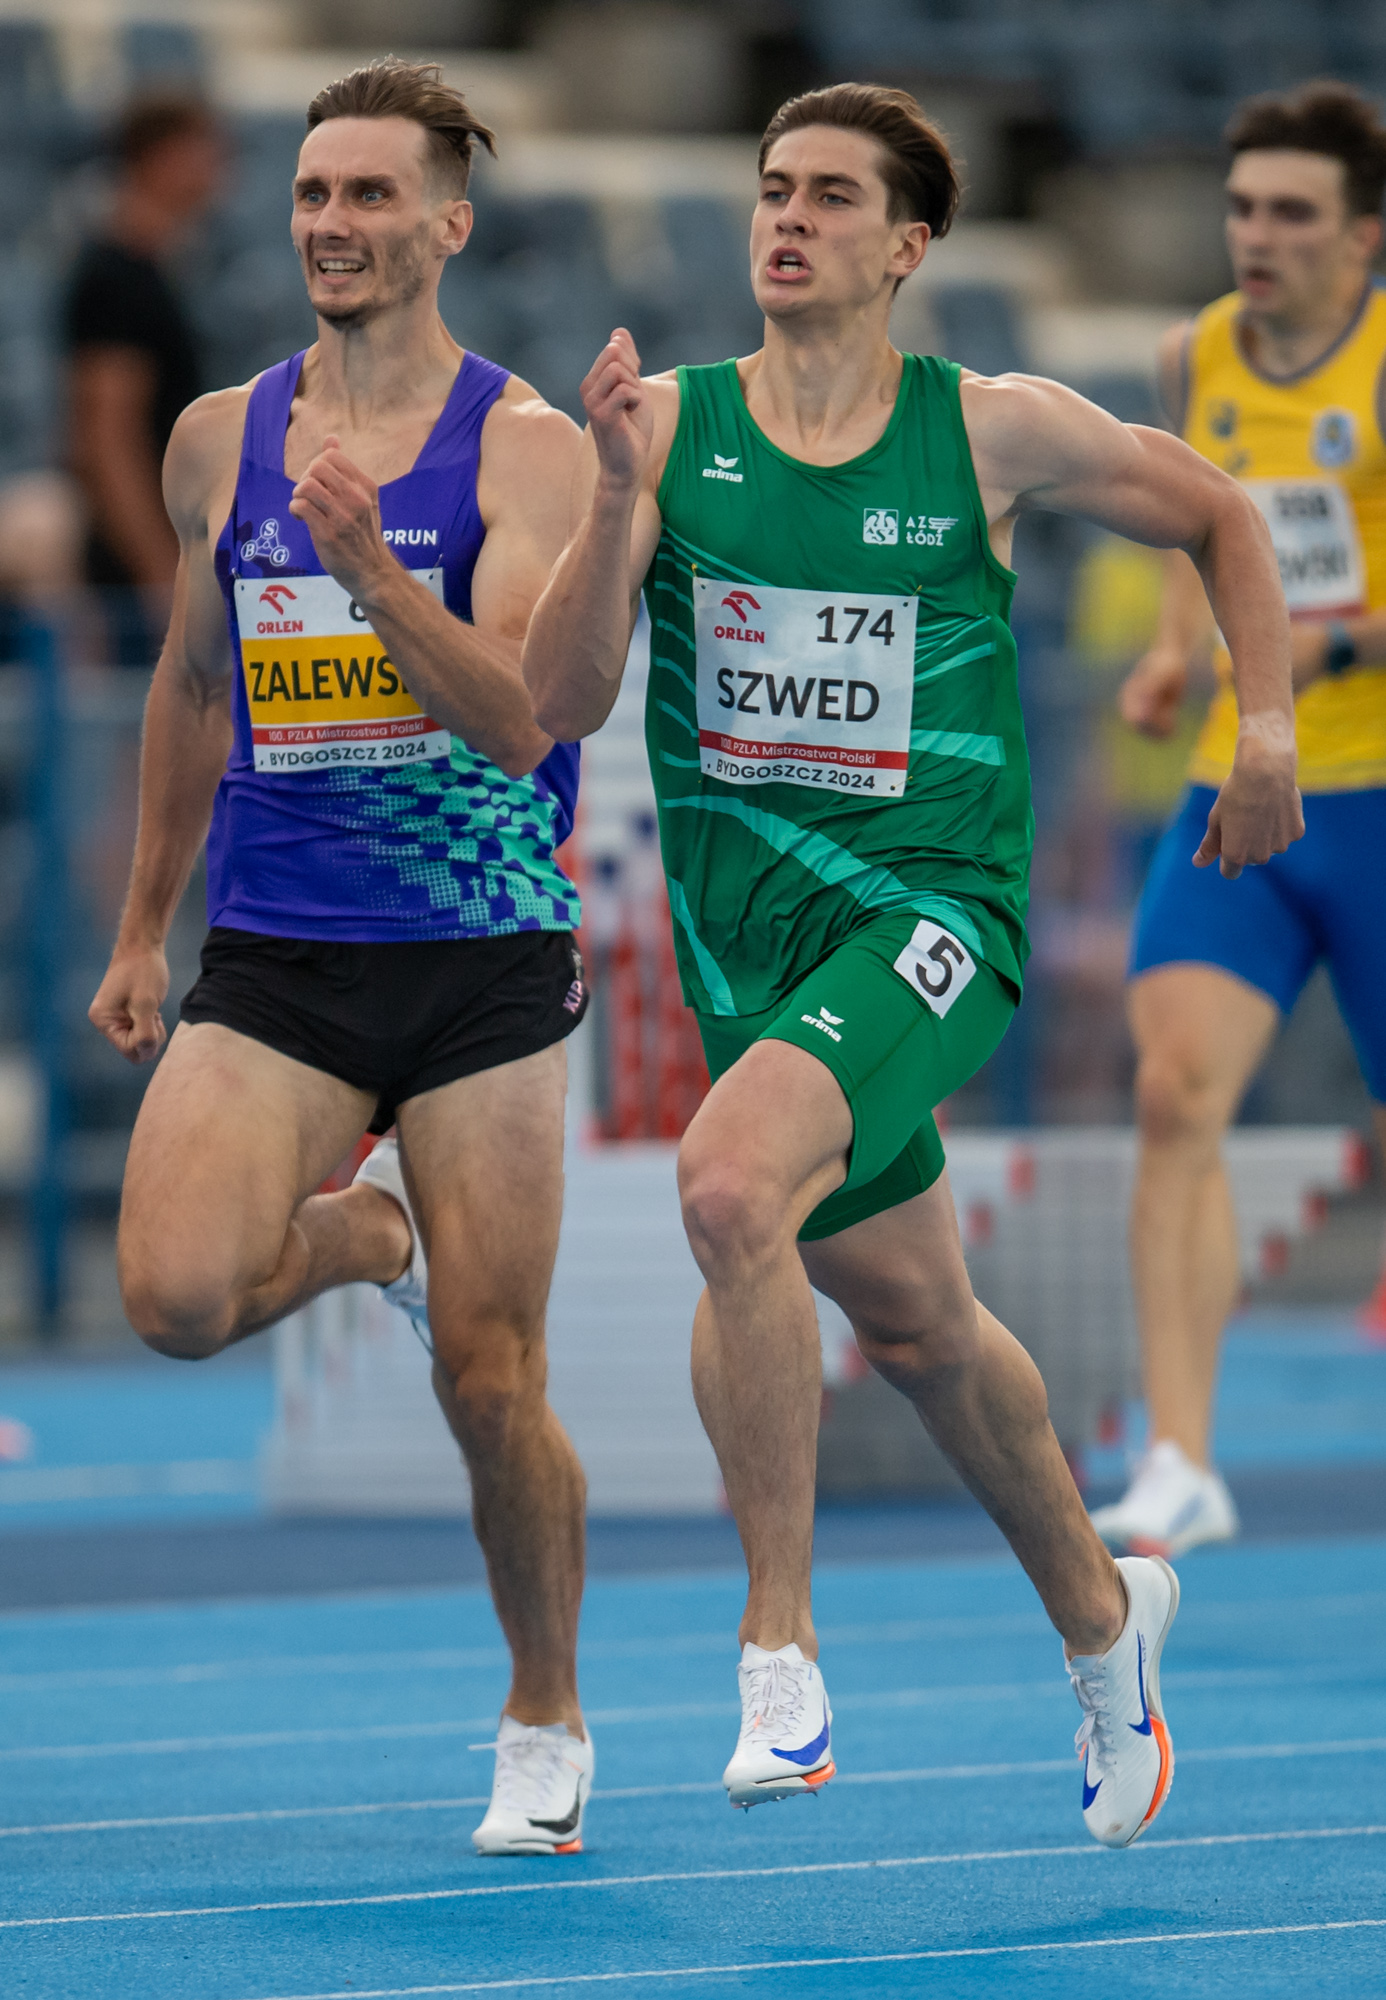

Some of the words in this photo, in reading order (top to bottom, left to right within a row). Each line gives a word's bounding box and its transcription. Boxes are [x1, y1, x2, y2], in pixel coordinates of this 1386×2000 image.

[702, 468, 744, 483] erima
[257, 620, 303, 634] ORLEN
[714, 625, 765, 644] ORLEN
[816, 605, 895, 646] 174
[249, 656, 409, 702] ZALEWS
[717, 667, 880, 722] SZWED
[287, 728, 314, 742] PZLA
[316, 724, 388, 740] Mistrzostwa
[390, 720, 425, 735] Polski
[270, 747, 378, 766] BYDGOSZCZ
[382, 741, 427, 760] 2024
[733, 742, 759, 756] PZLA
[762, 745, 837, 761] Mistrzostwa
[839, 751, 876, 765] Polski
[716, 758, 822, 783] BYDGOSZCZ
[827, 769, 876, 789] 2024
[915, 934, 965, 998] 5
[800, 1014, 842, 1043] erima
